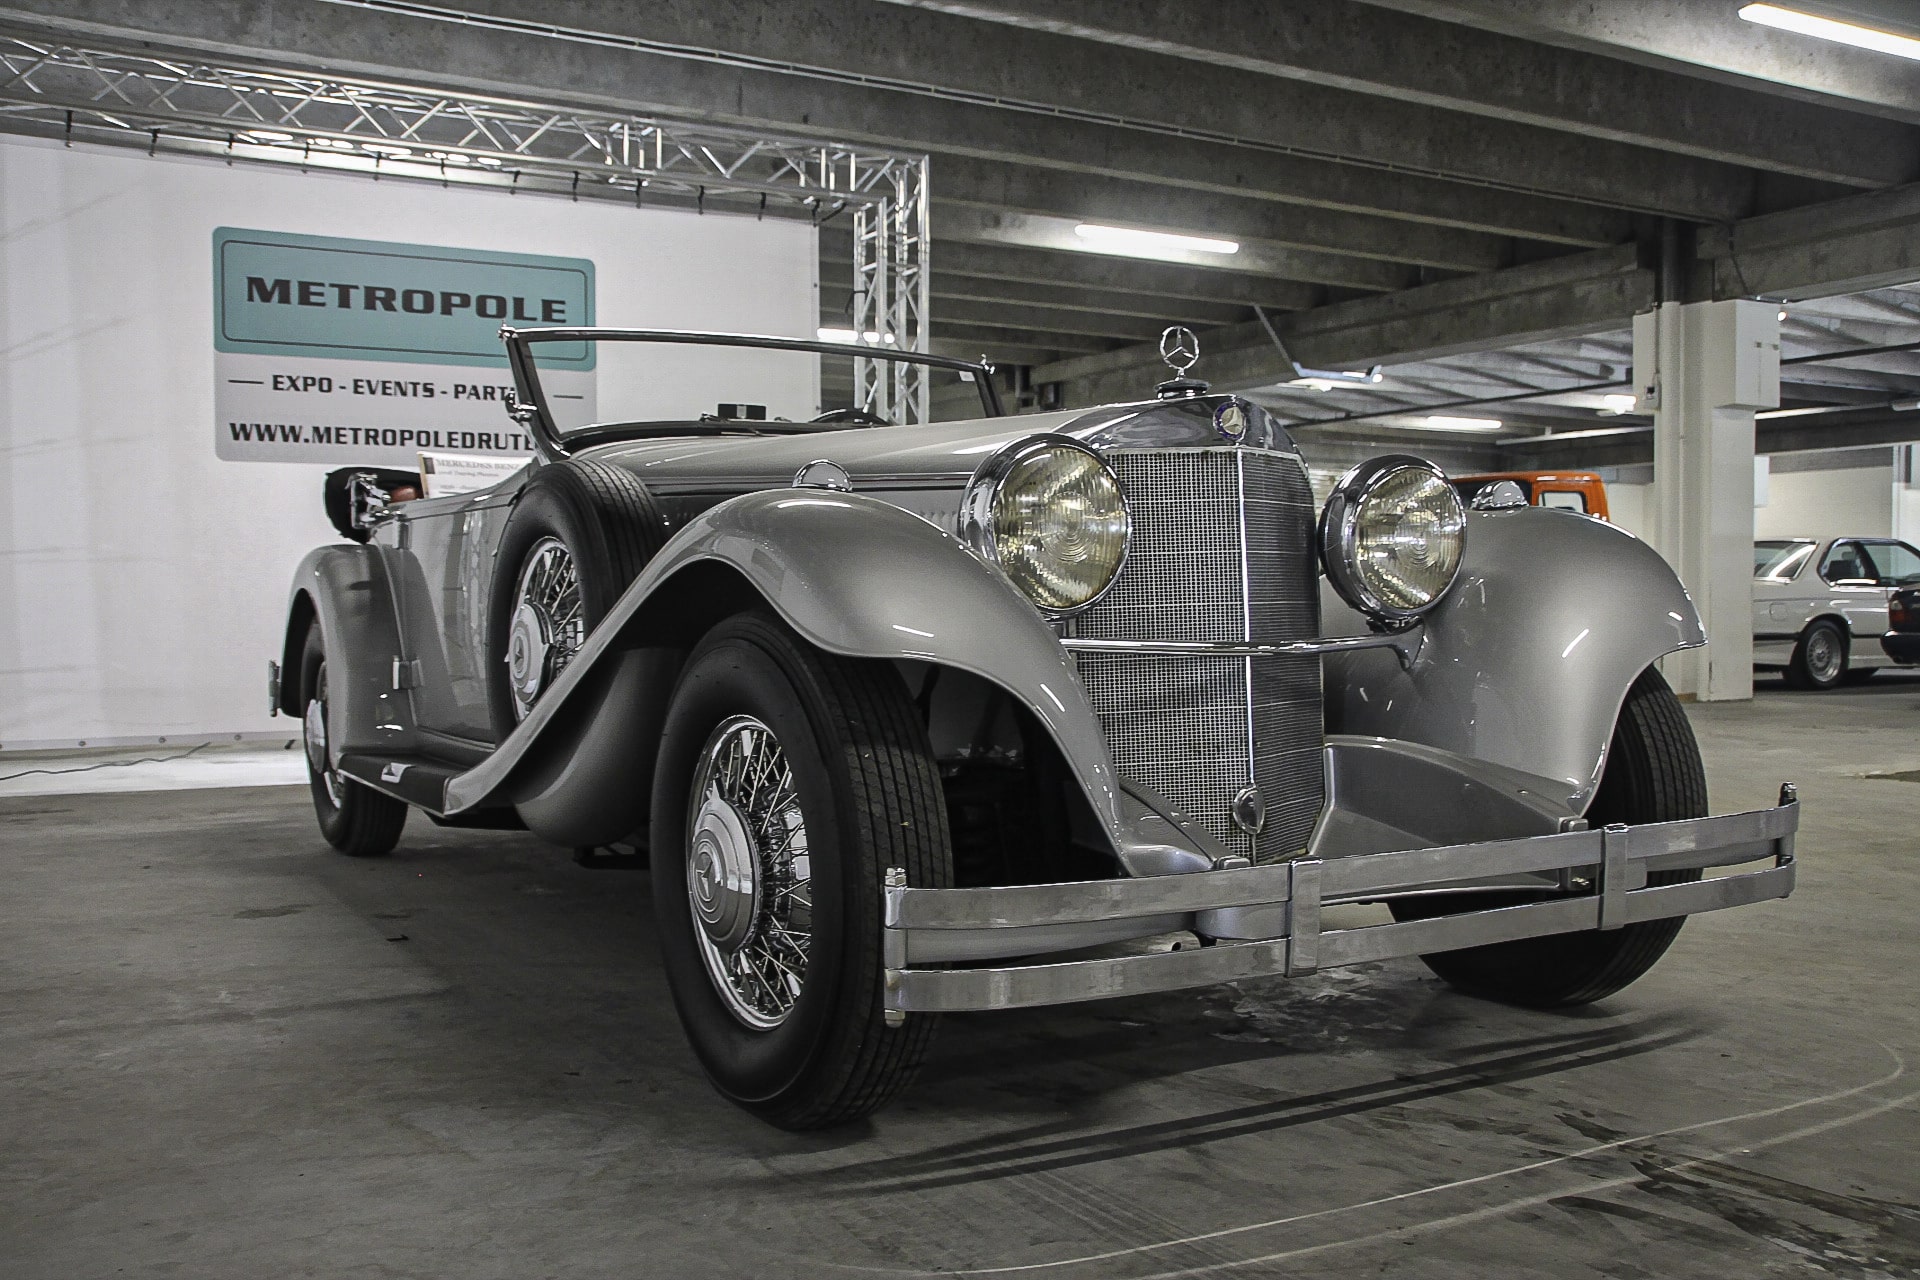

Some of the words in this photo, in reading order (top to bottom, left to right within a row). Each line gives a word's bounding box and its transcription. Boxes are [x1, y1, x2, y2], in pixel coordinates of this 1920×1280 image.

[246, 276, 567, 323] METROPOLE
[272, 374, 333, 393] EXPO
[352, 378, 435, 398] EVENTS
[453, 384, 515, 401] PART
